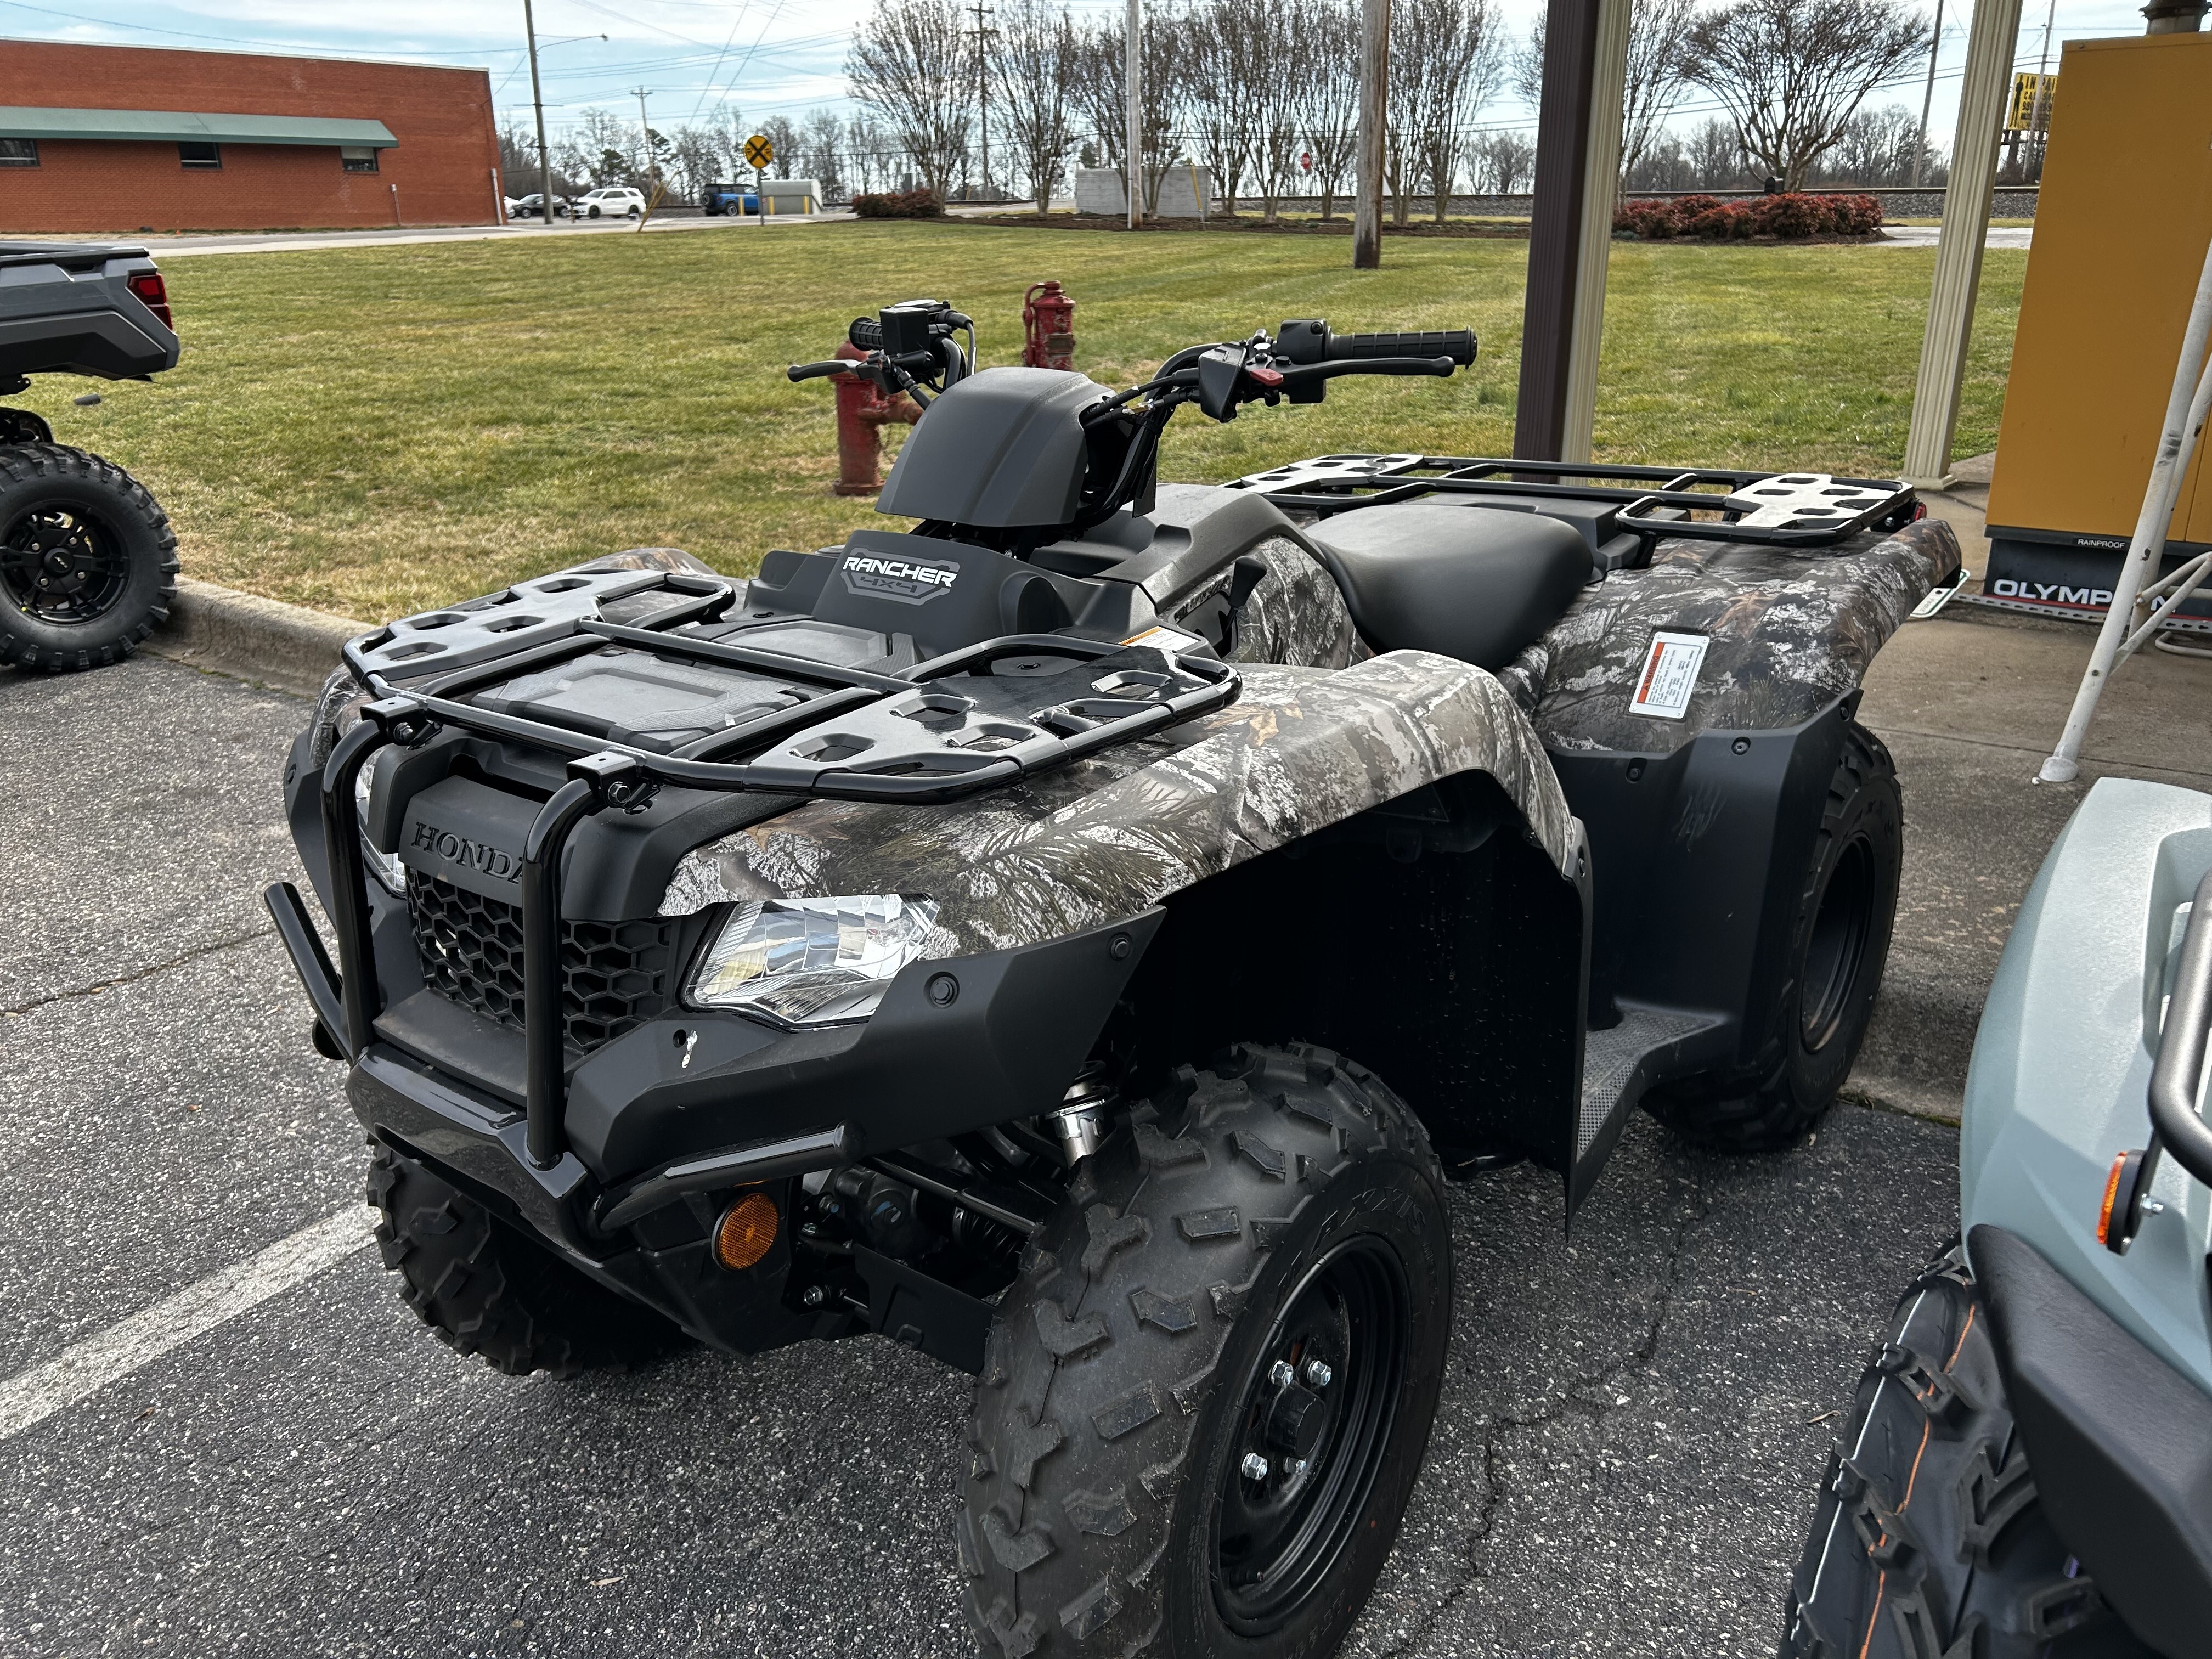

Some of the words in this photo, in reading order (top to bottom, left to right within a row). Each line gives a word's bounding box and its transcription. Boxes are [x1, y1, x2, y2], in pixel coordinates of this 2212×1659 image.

[2025, 75, 2036, 89] IN
[2077, 538, 2126, 549] RAINPROOF
[842, 556, 957, 588] RANCHER
[1645, 655, 1660, 685] WARNING
[1274, 1187, 1426, 1305] MAXXIS
